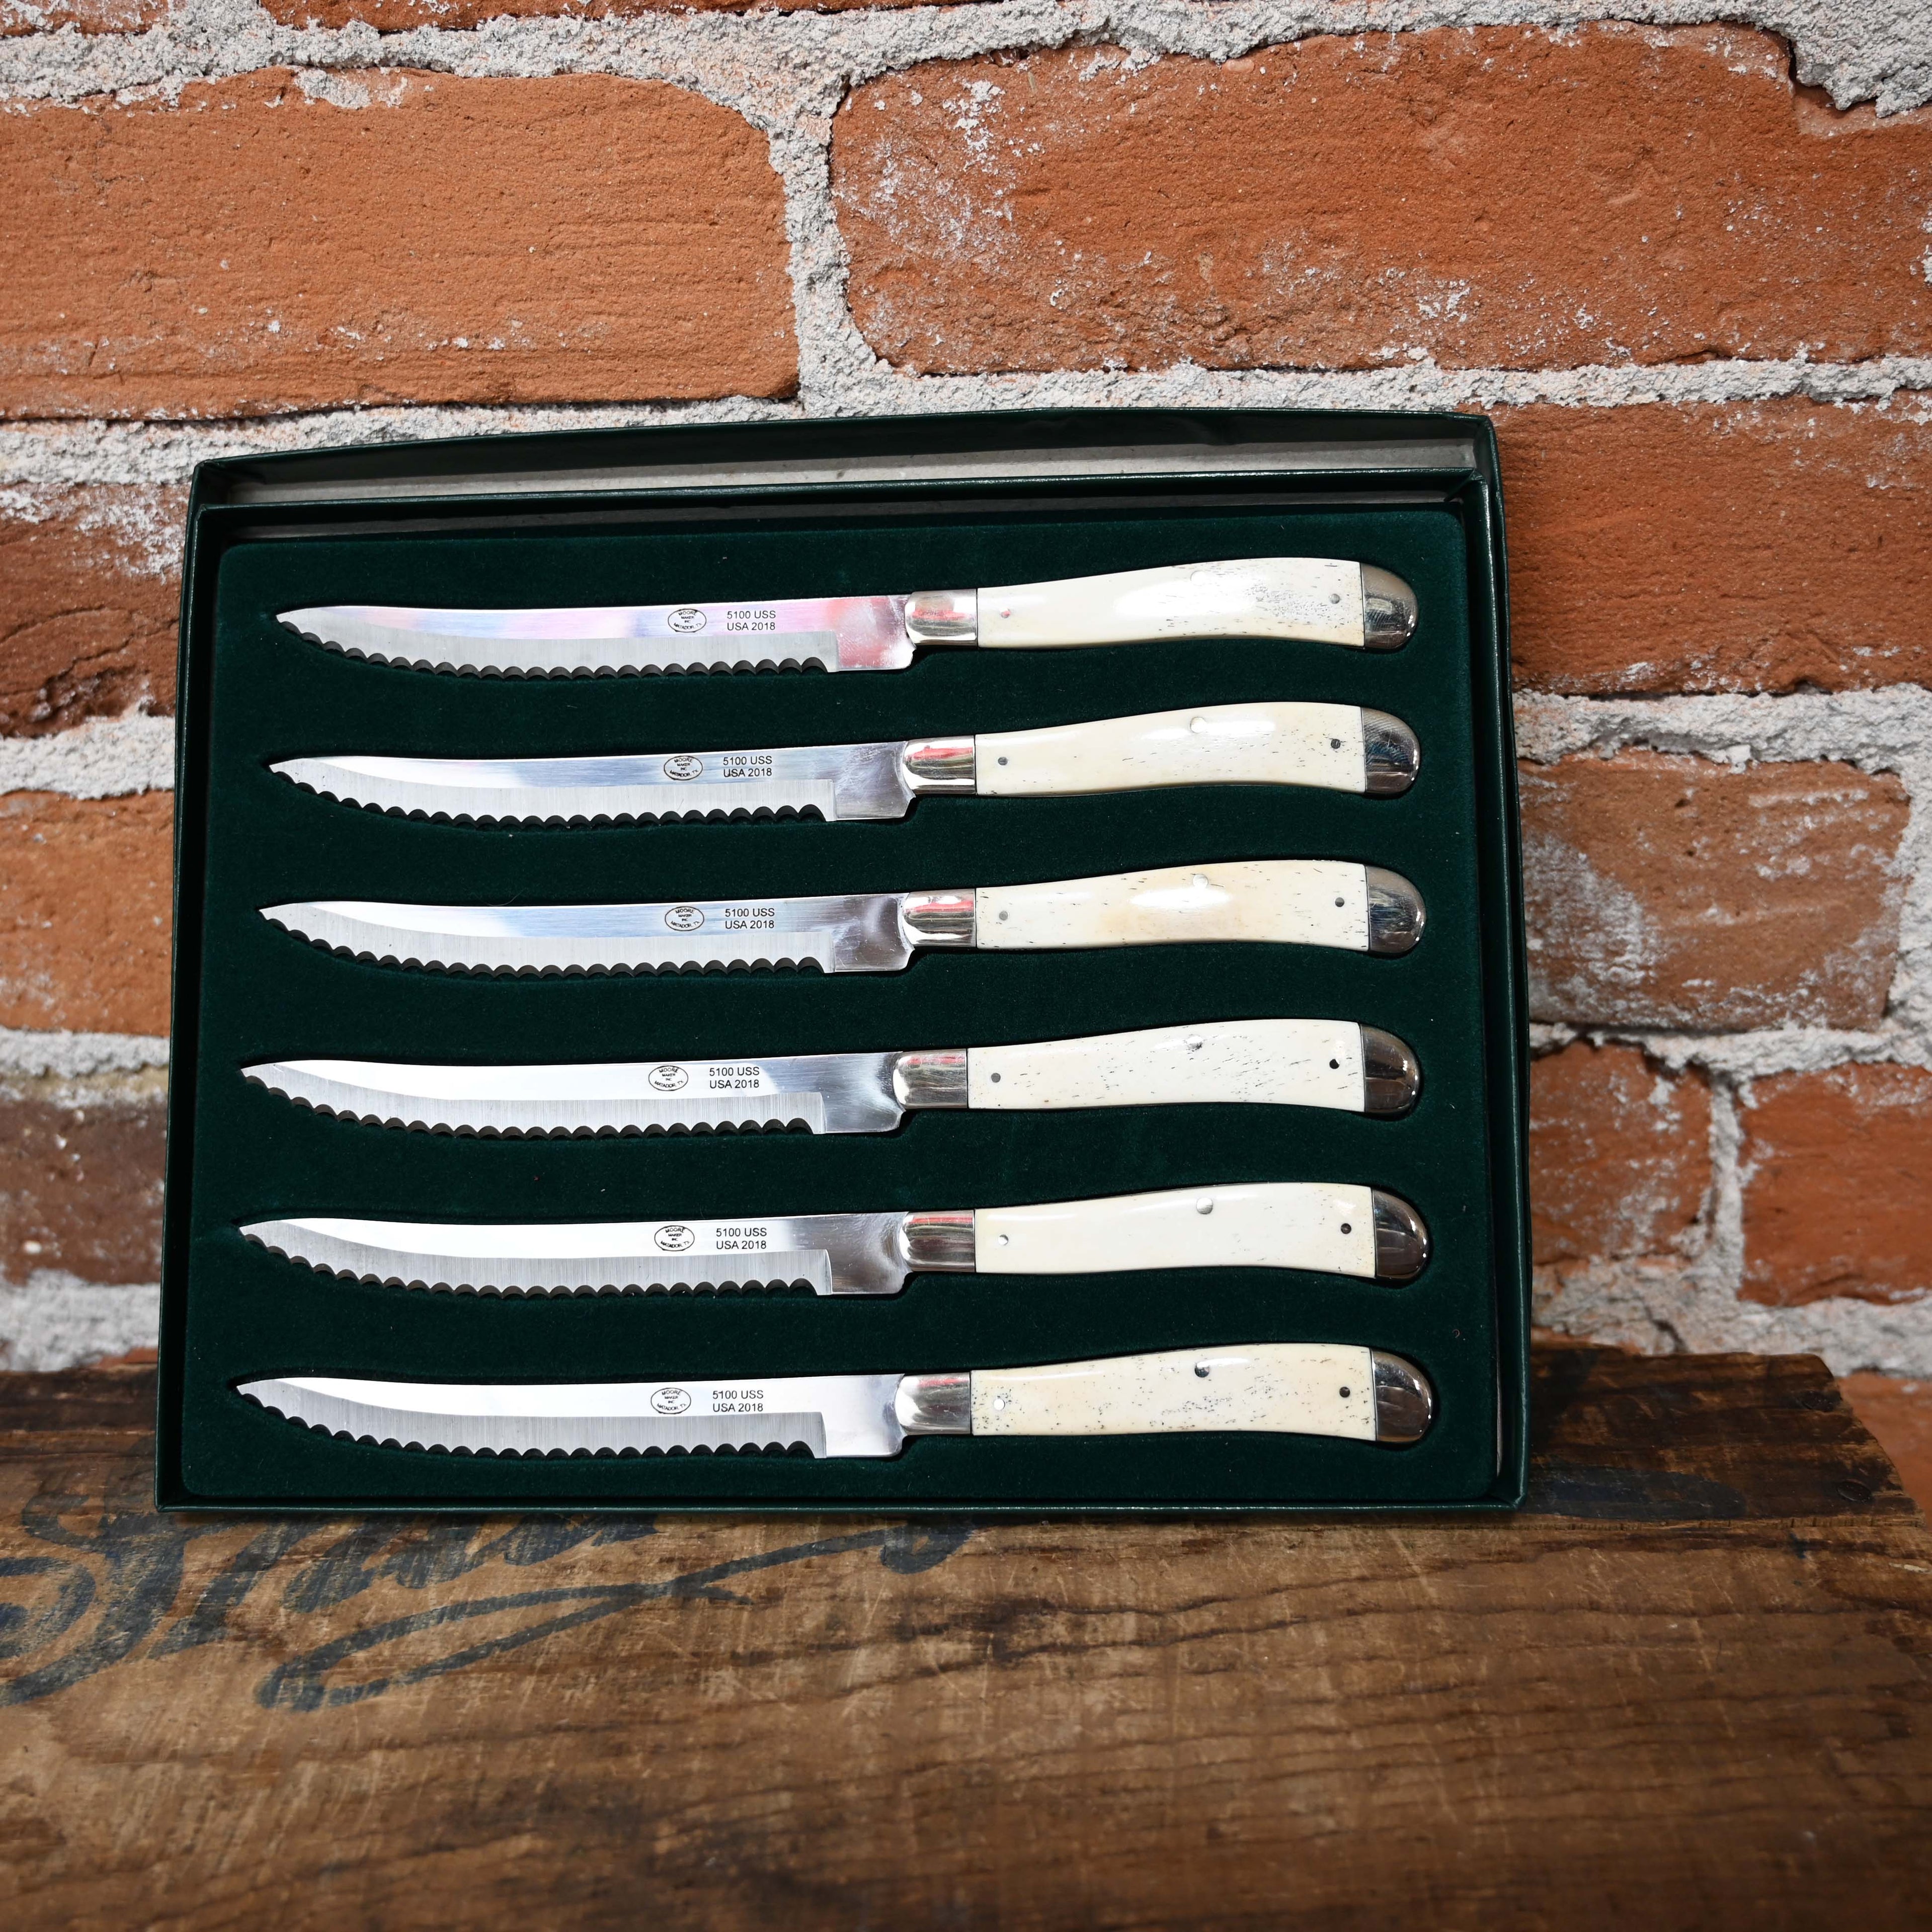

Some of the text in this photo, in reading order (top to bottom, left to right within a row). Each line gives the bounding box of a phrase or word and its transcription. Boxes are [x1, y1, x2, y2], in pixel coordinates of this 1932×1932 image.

[727, 610, 776, 619] 5100 USS
[727, 622, 775, 631] USA 2018
[723, 756, 772, 765] 5100 USS
[723, 768, 772, 777] USA 2018
[725, 908, 775, 917] 5100 USS
[725, 920, 774, 929] USA 2018
[709, 1067, 760, 1076] 5100 USS
[709, 1080, 759, 1089] USA 2018
[716, 1228, 767, 1237] 5100 USS
[716, 1240, 767, 1249] USA 2018
[712, 1390, 763, 1399] 5100 USS
[713, 1403, 763, 1412] USA 2018
